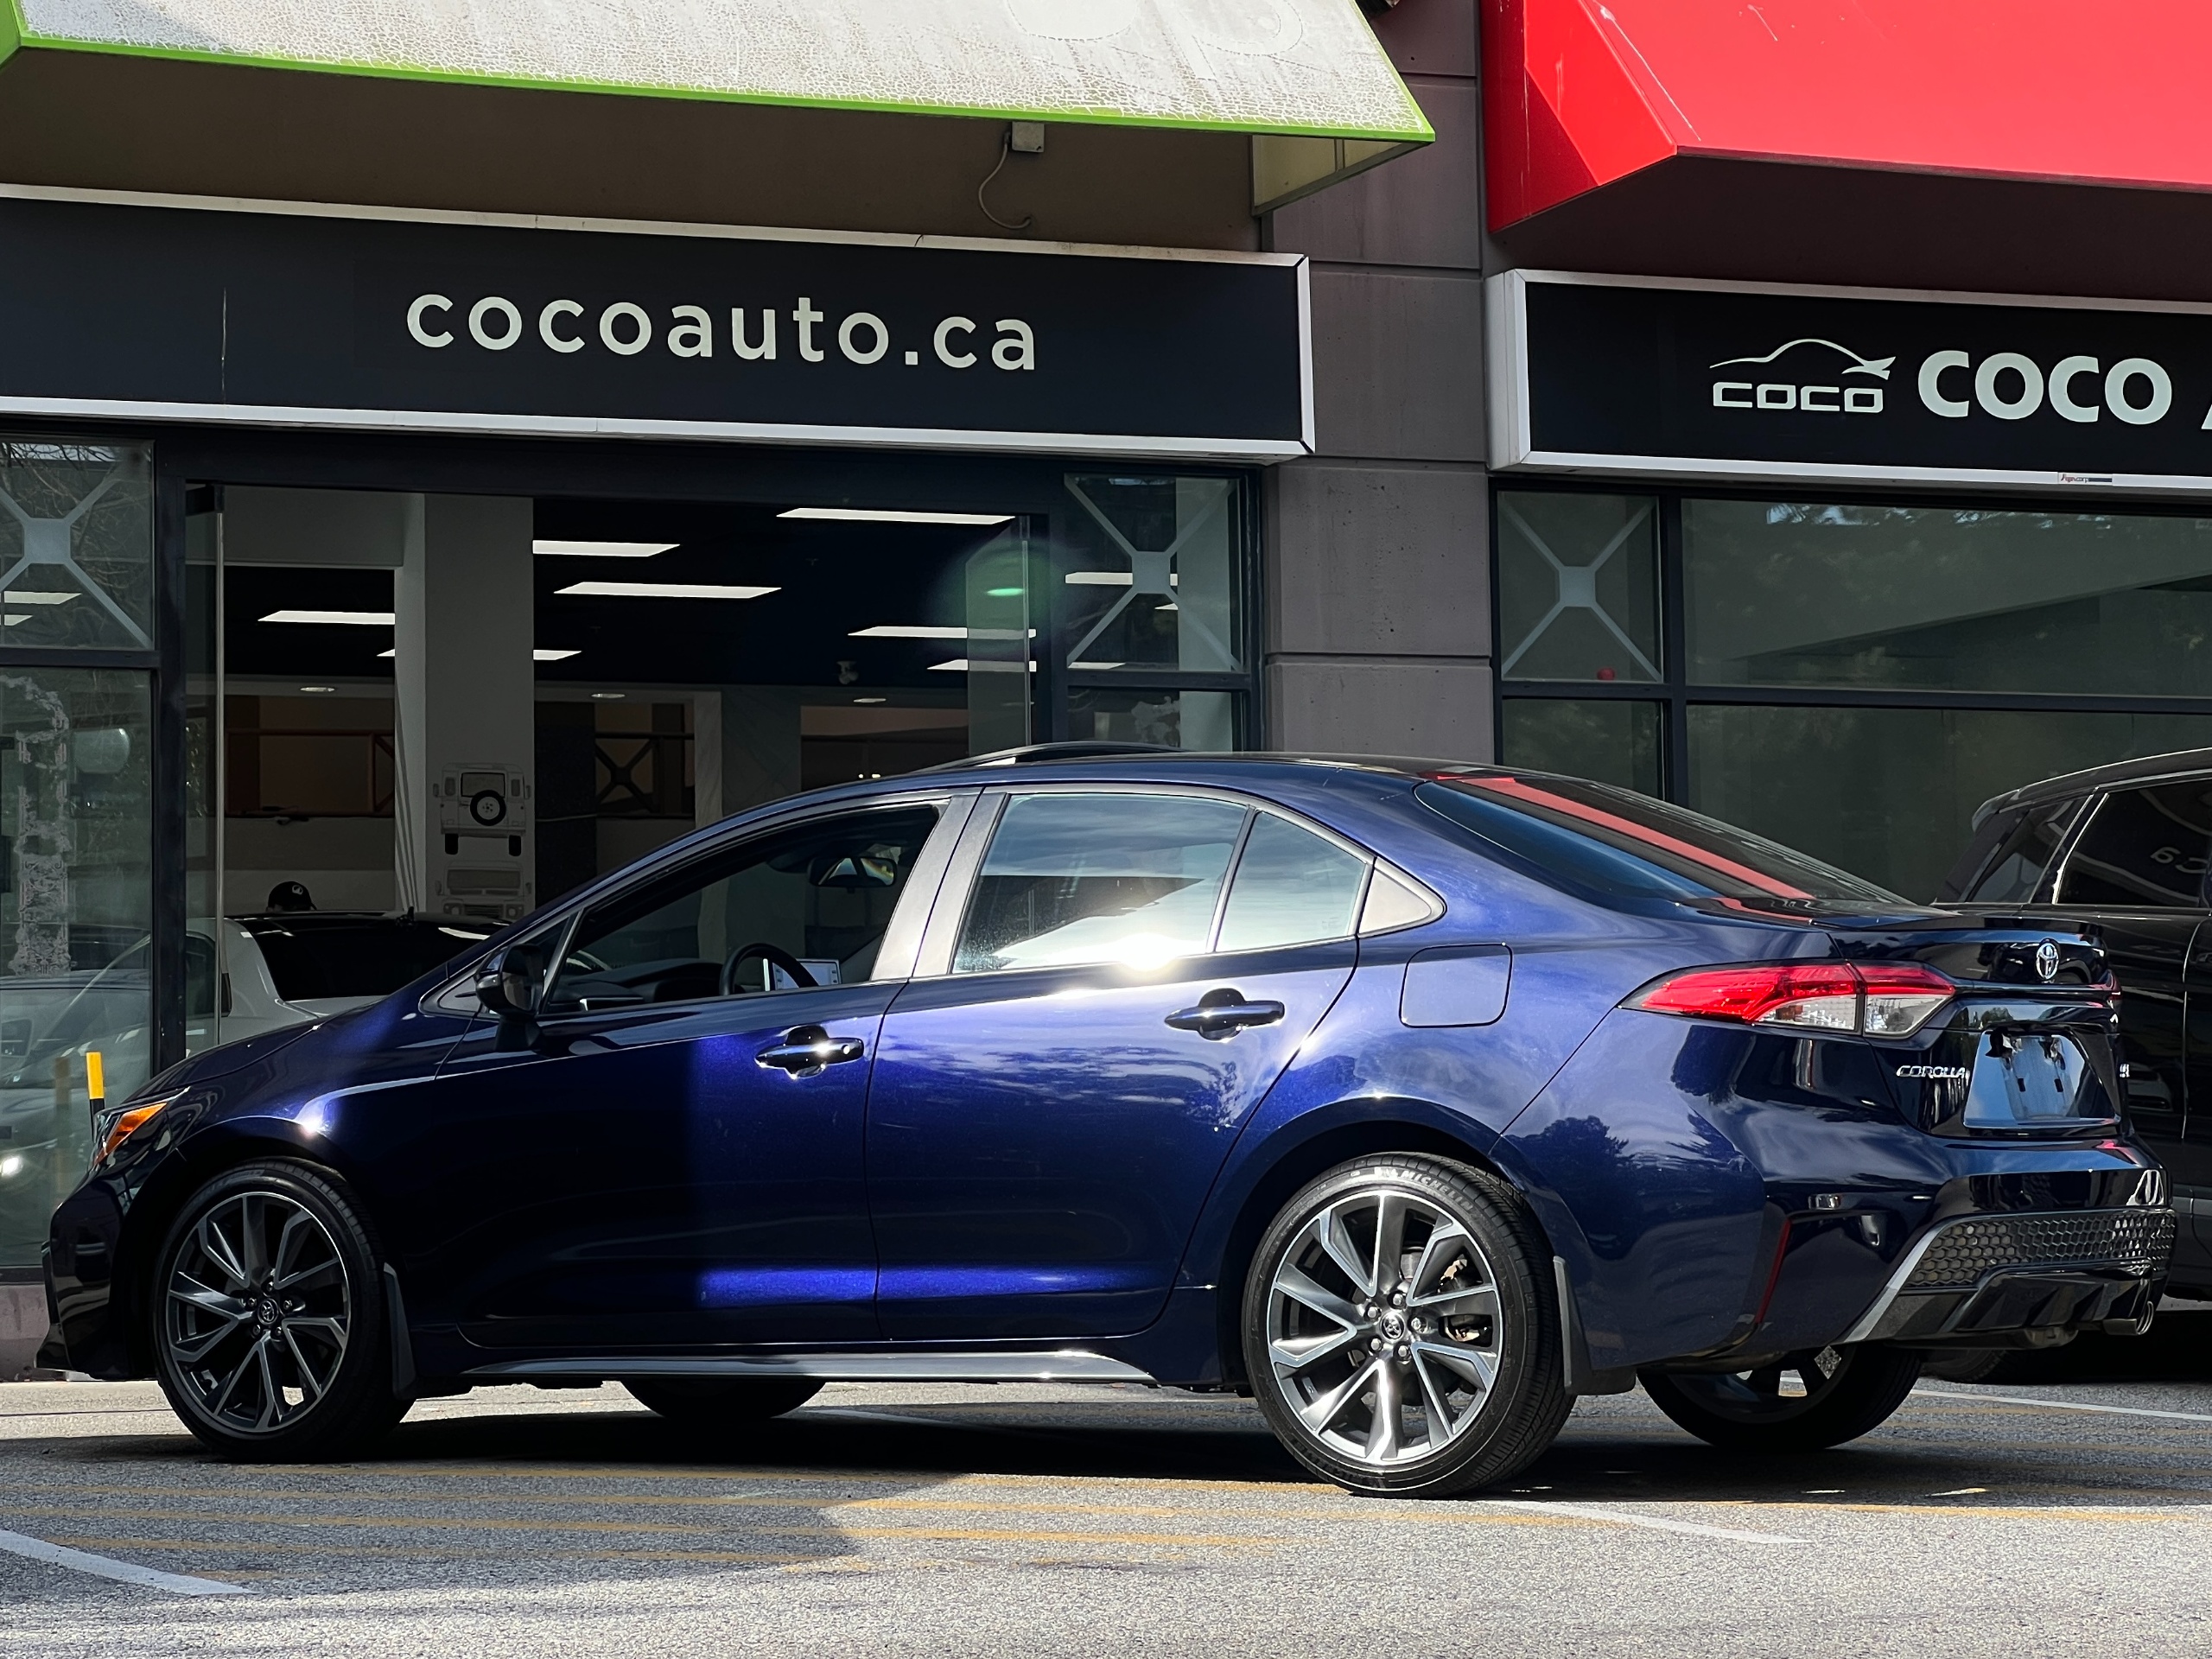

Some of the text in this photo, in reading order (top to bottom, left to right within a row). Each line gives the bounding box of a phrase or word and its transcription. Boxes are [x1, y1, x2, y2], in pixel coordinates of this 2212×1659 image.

[407, 294, 1035, 371] cocoauto.ca
[1713, 382, 1884, 414] COCO
[1917, 350, 2172, 424] COCO
[1896, 1065, 1967, 1079] COROLLA
[1401, 1170, 1474, 1210] MICHELIN
